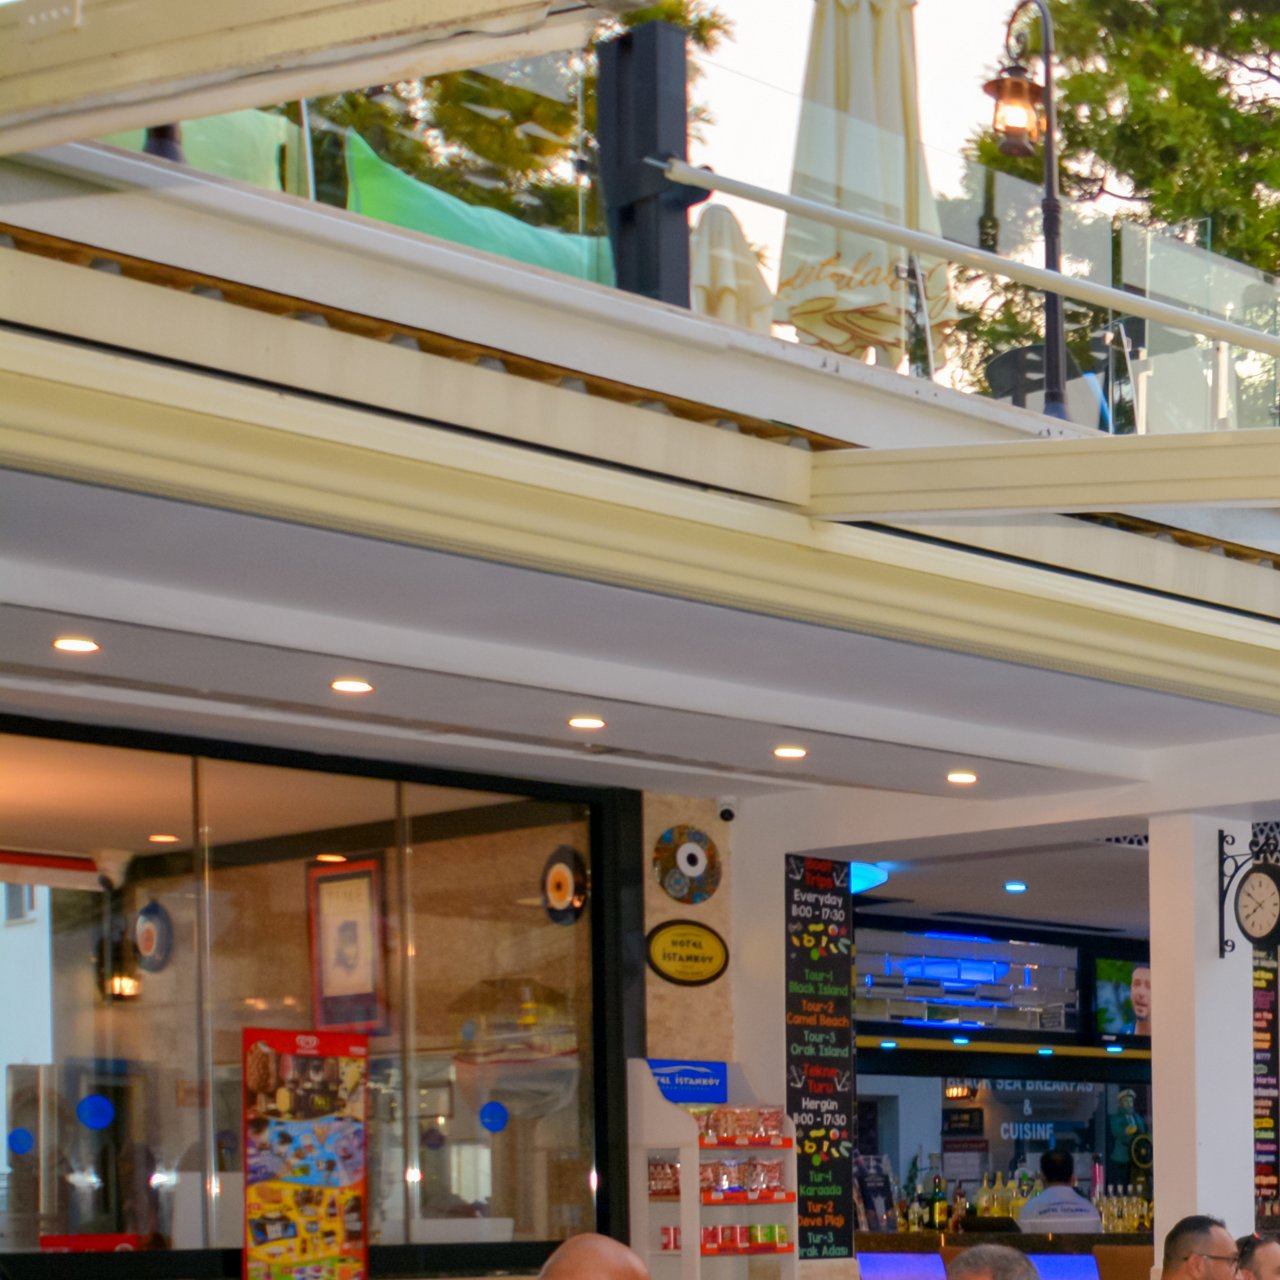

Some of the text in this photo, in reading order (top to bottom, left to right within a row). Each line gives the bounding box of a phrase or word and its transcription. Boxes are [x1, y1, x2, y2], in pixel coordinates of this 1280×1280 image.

[794, 889, 843, 907] Everyday
[821, 908, 845, 921] 17:30
[671, 938, 704, 950] HOTEL
[804, 969, 833, 981] Tour-1
[818, 983, 849, 997] Island
[801, 999, 834, 1013] Tour-2
[787, 1012, 849, 1028] Camel Beach
[803, 1030, 836, 1044] Tour-3
[790, 1043, 850, 1058] Orak Island
[655, 1076, 671, 1085] TEL
[808, 1080, 833, 1094] Turu
[996, 1079, 1022, 1091] SEA
[802, 1097, 838, 1112] Hergün
[1023, 1098, 1033, 1116] &
[823, 1113, 846, 1126] 17:30
[809, 1170, 832, 1182] Tur-1
[799, 1184, 842, 1196] Karaada
[807, 1200, 834, 1213] Tur-2
[807, 1231, 834, 1244] Tur-3
